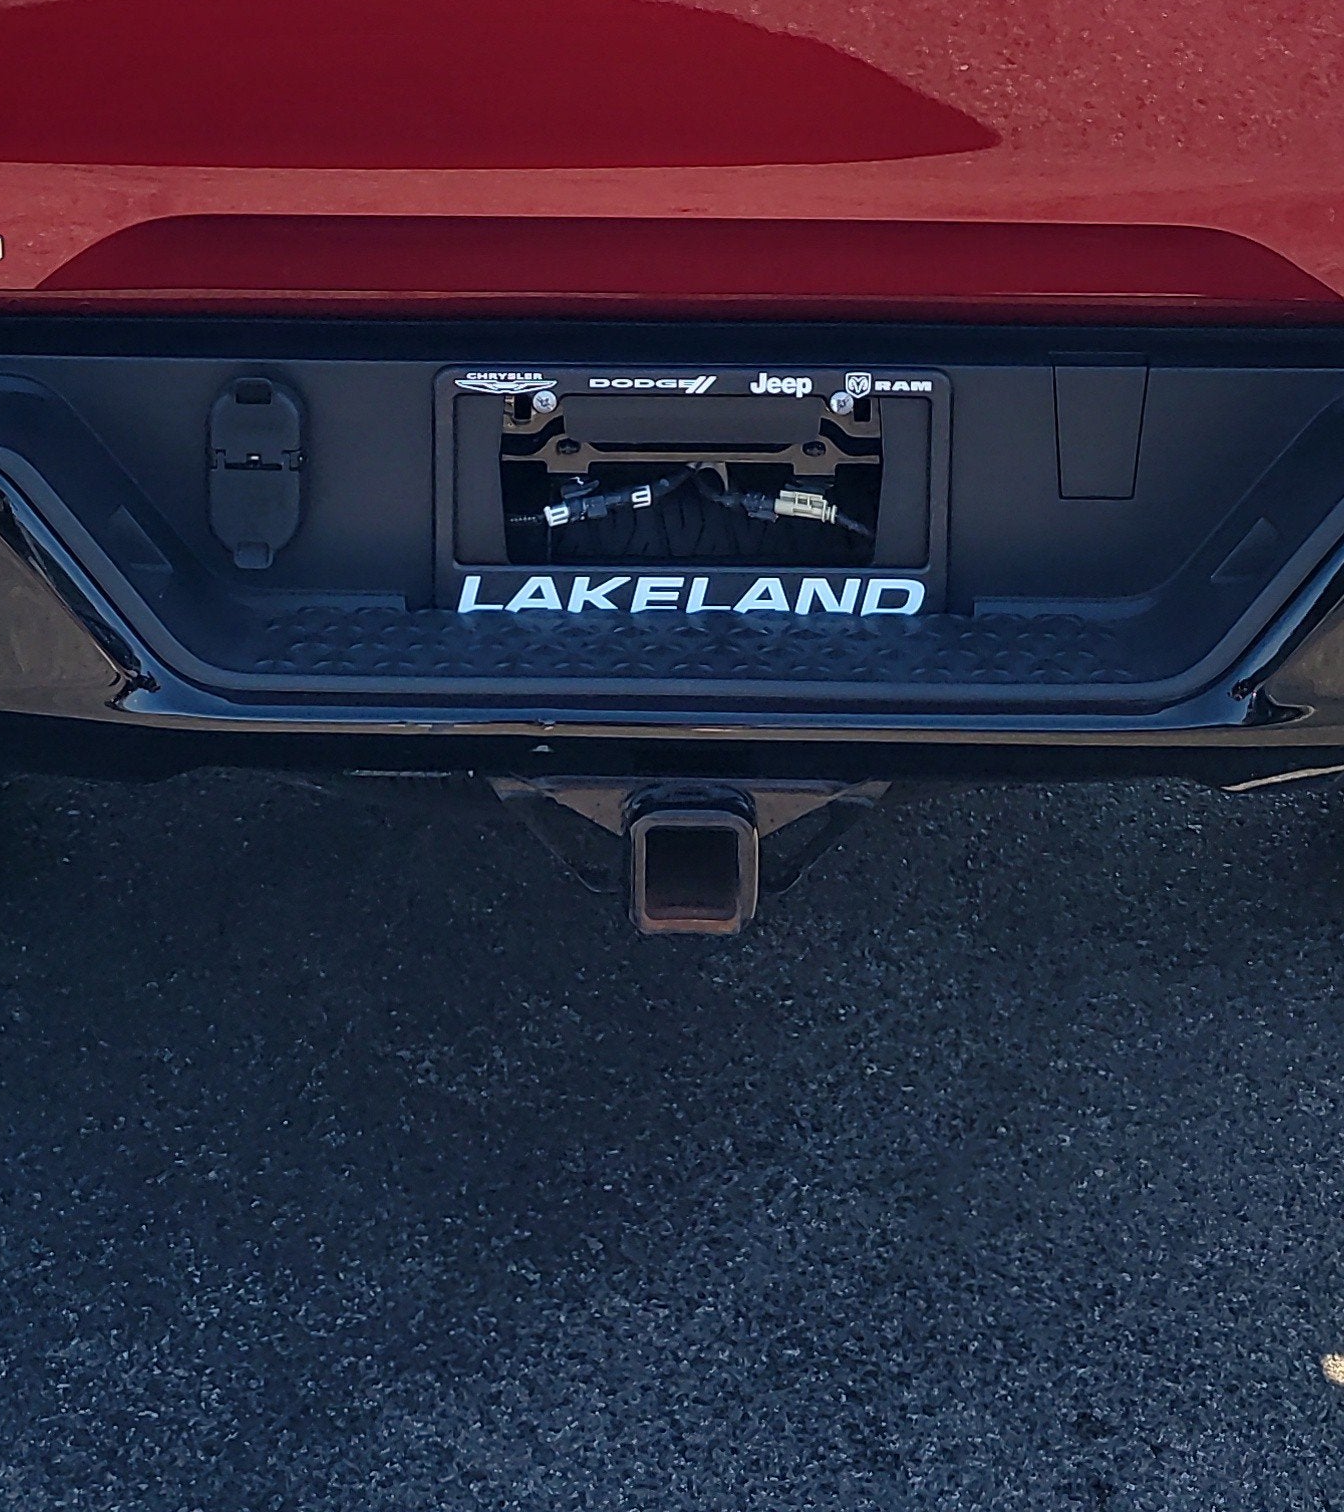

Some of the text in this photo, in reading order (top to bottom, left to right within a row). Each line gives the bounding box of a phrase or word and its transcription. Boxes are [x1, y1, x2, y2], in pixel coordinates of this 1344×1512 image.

[466, 372, 543, 381] CHRYSLER
[589, 378, 696, 389] DODGE
[750, 372, 812, 397] Jeep
[875, 381, 932, 391] RAM
[457, 575, 926, 615] LAKELAND
